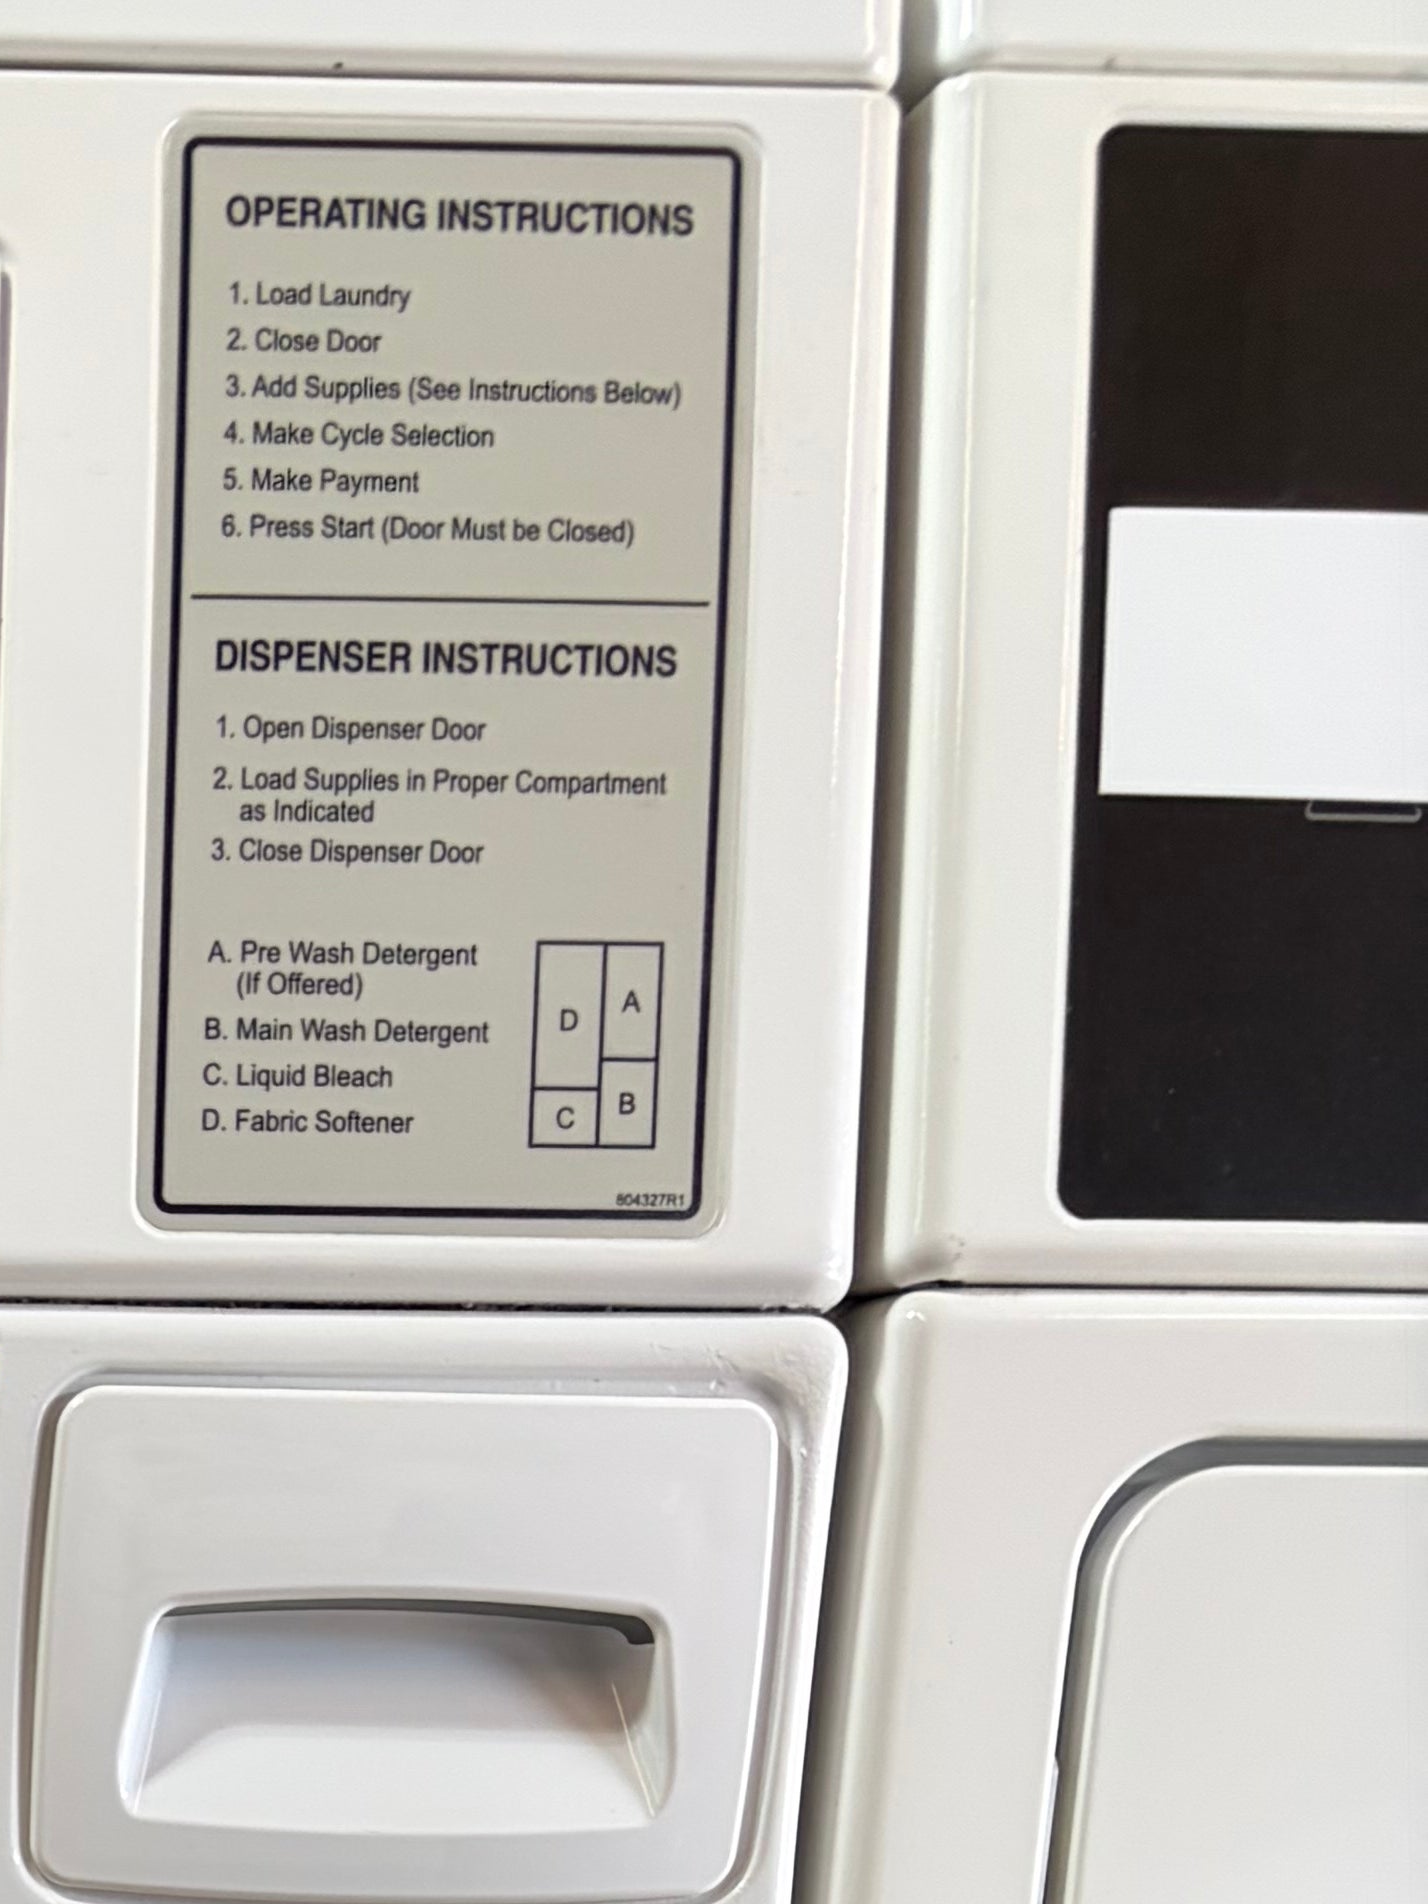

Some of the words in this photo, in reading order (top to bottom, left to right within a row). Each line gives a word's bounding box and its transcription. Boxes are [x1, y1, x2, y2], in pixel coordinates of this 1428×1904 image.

[226, 195, 426, 230] OPERATING
[438, 200, 693, 236] INSTRUCTIONS
[230, 282, 248, 304] 1.
[257, 282, 312, 305] Load
[320, 284, 411, 313] Laundry
[227, 327, 246, 351] 2.
[255, 327, 319, 352] Close
[327, 328, 382, 352] Door
[226, 374, 245, 397] 3.
[252, 375, 297, 398] Add
[305, 375, 401, 404] Supplies
[409, 376, 461, 404] (See
[470, 378, 597, 403] Instructions
[604, 380, 681, 410] Below)
[224, 421, 244, 443] 4.
[253, 421, 314, 444] Make
[321, 422, 384, 451] Cycle
[392, 423, 494, 447] Selection
[224, 467, 242, 490] 5.
[252, 468, 312, 491] Make
[320, 468, 419, 497] Payment
[222, 514, 241, 537] 6.
[250, 514, 314, 538] Press
[321, 515, 374, 539] Start
[382, 516, 445, 544] (Door
[452, 517, 505, 541] Must
[513, 519, 540, 541] be
[548, 518, 634, 548] Closed)
[216, 639, 411, 673] DISPENSER
[423, 642, 677, 677] INSTRUCTIONS
[217, 715, 234, 738] 1.
[244, 715, 304, 743] Open
[312, 715, 425, 744] Dispenser
[432, 717, 486, 741] Door
[213, 766, 232, 790] 2.
[242, 767, 296, 790] Load
[304, 767, 399, 796] Supplies
[407, 770, 425, 791] in
[434, 768, 509, 798] Proper
[516, 770, 666, 799] Compartment
[240, 804, 266, 821] as
[274, 799, 374, 822] Indicated
[212, 838, 230, 861] 3.
[239, 838, 302, 861] Close
[311, 839, 423, 867] Dispenser
[430, 840, 484, 863] Door
[208, 940, 231, 963] A.
[241, 940, 281, 963] Pre
[289, 941, 354, 964] Wash
[363, 942, 477, 971] Detergent
[237, 971, 261, 1000] (If
[267, 972, 363, 1001] Offered)
[560, 1009, 578, 1031] D
[622, 990, 640, 1012] A
[205, 1017, 227, 1040] B.
[237, 1018, 292, 1040] Main
[301, 1019, 365, 1041] Wash
[375, 1019, 488, 1048] Detergent
[203, 1062, 227, 1086] C.
[237, 1064, 305, 1092] Liquid
[314, 1064, 392, 1087] Bleach
[202, 1108, 226, 1131] D.
[236, 1109, 307, 1132] Fabric
[315, 1110, 414, 1133] Softener
[556, 1107, 574, 1129] C
[619, 1092, 635, 1115] B
